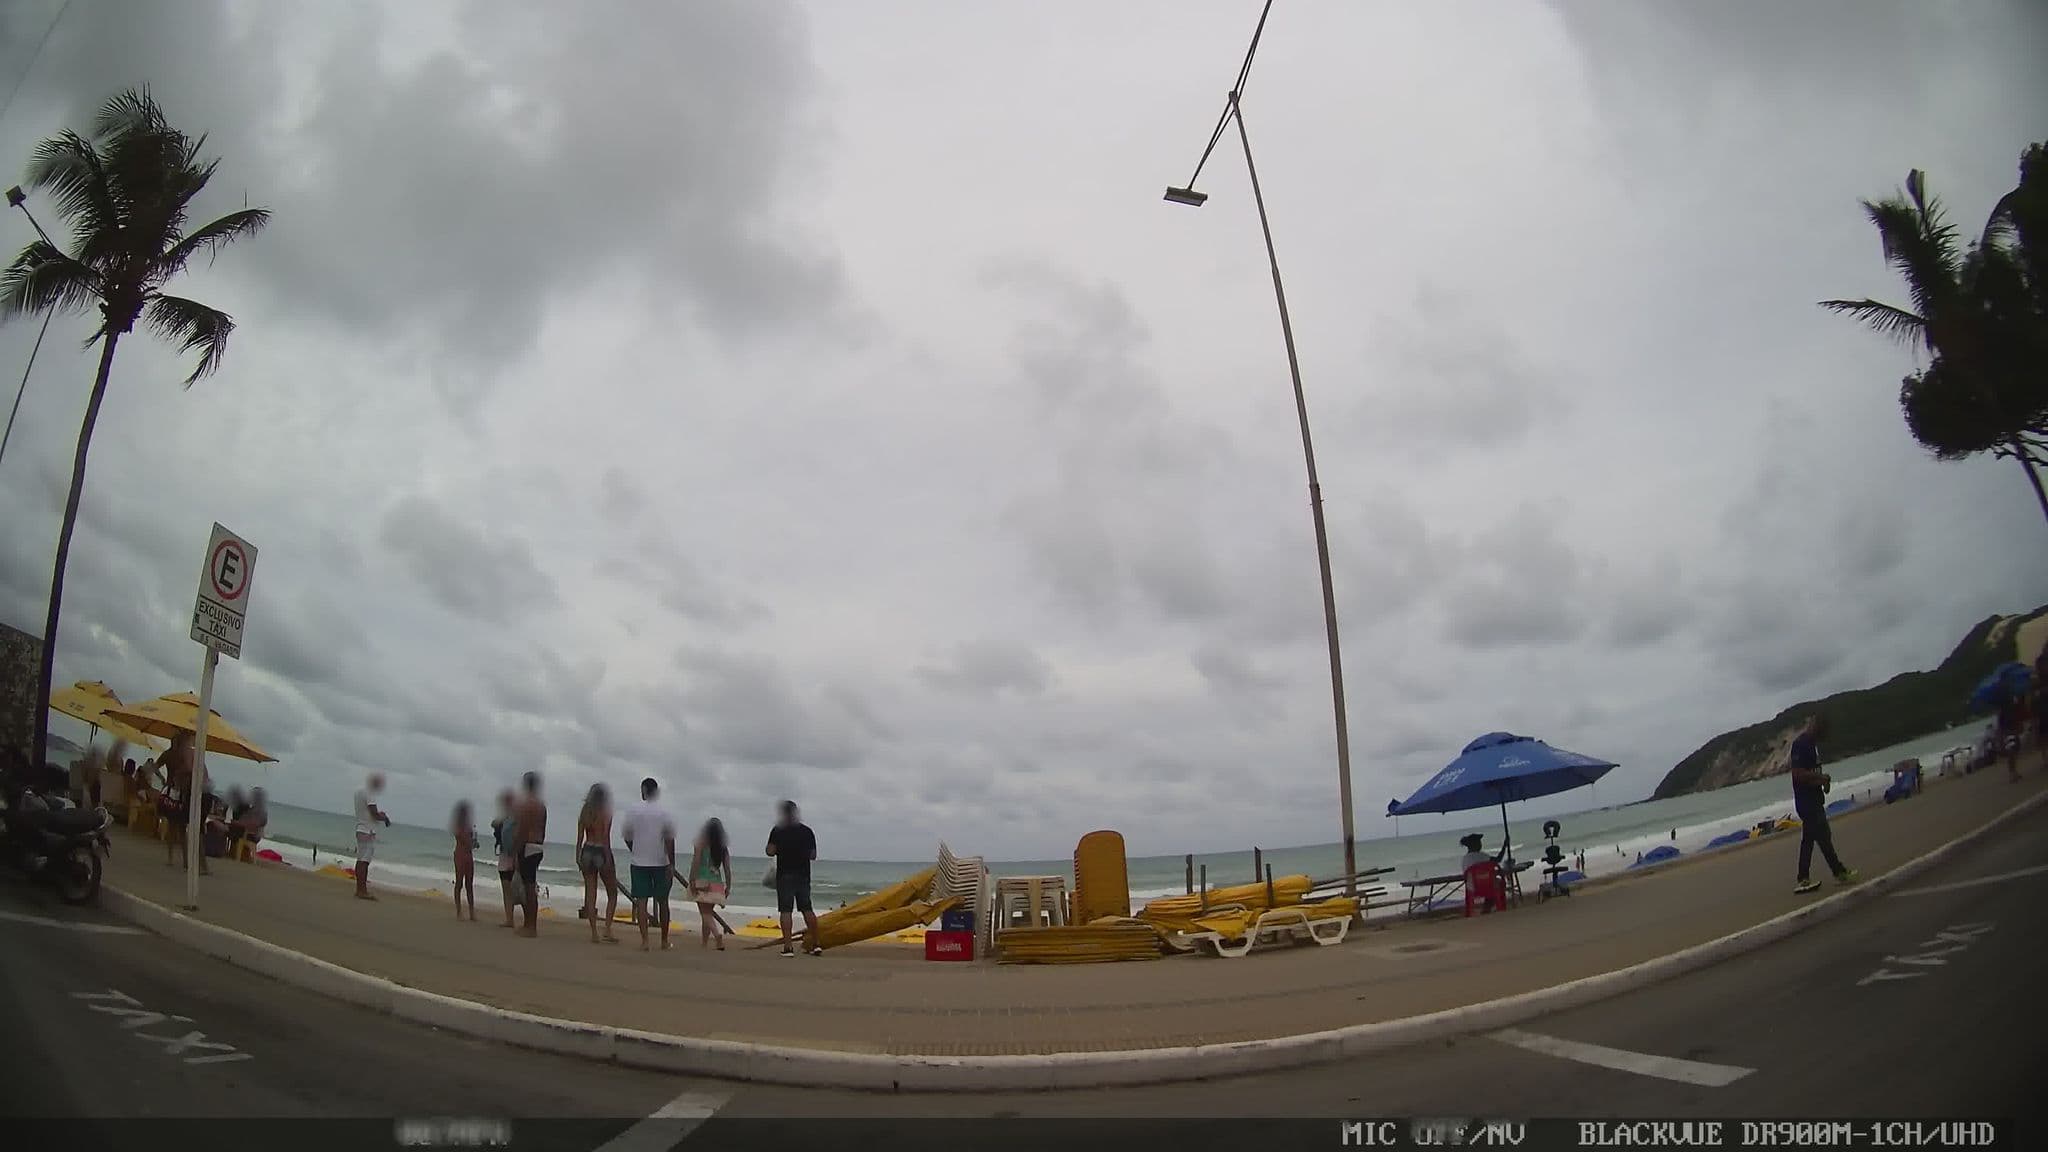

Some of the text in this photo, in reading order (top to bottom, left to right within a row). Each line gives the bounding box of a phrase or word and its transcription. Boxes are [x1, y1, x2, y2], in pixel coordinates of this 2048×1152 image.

[219, 549, 239, 590] E
[199, 601, 241, 630] EXCLUSIVO
[209, 620, 227, 638] TAXI
[68, 988, 254, 1063] TAXI
